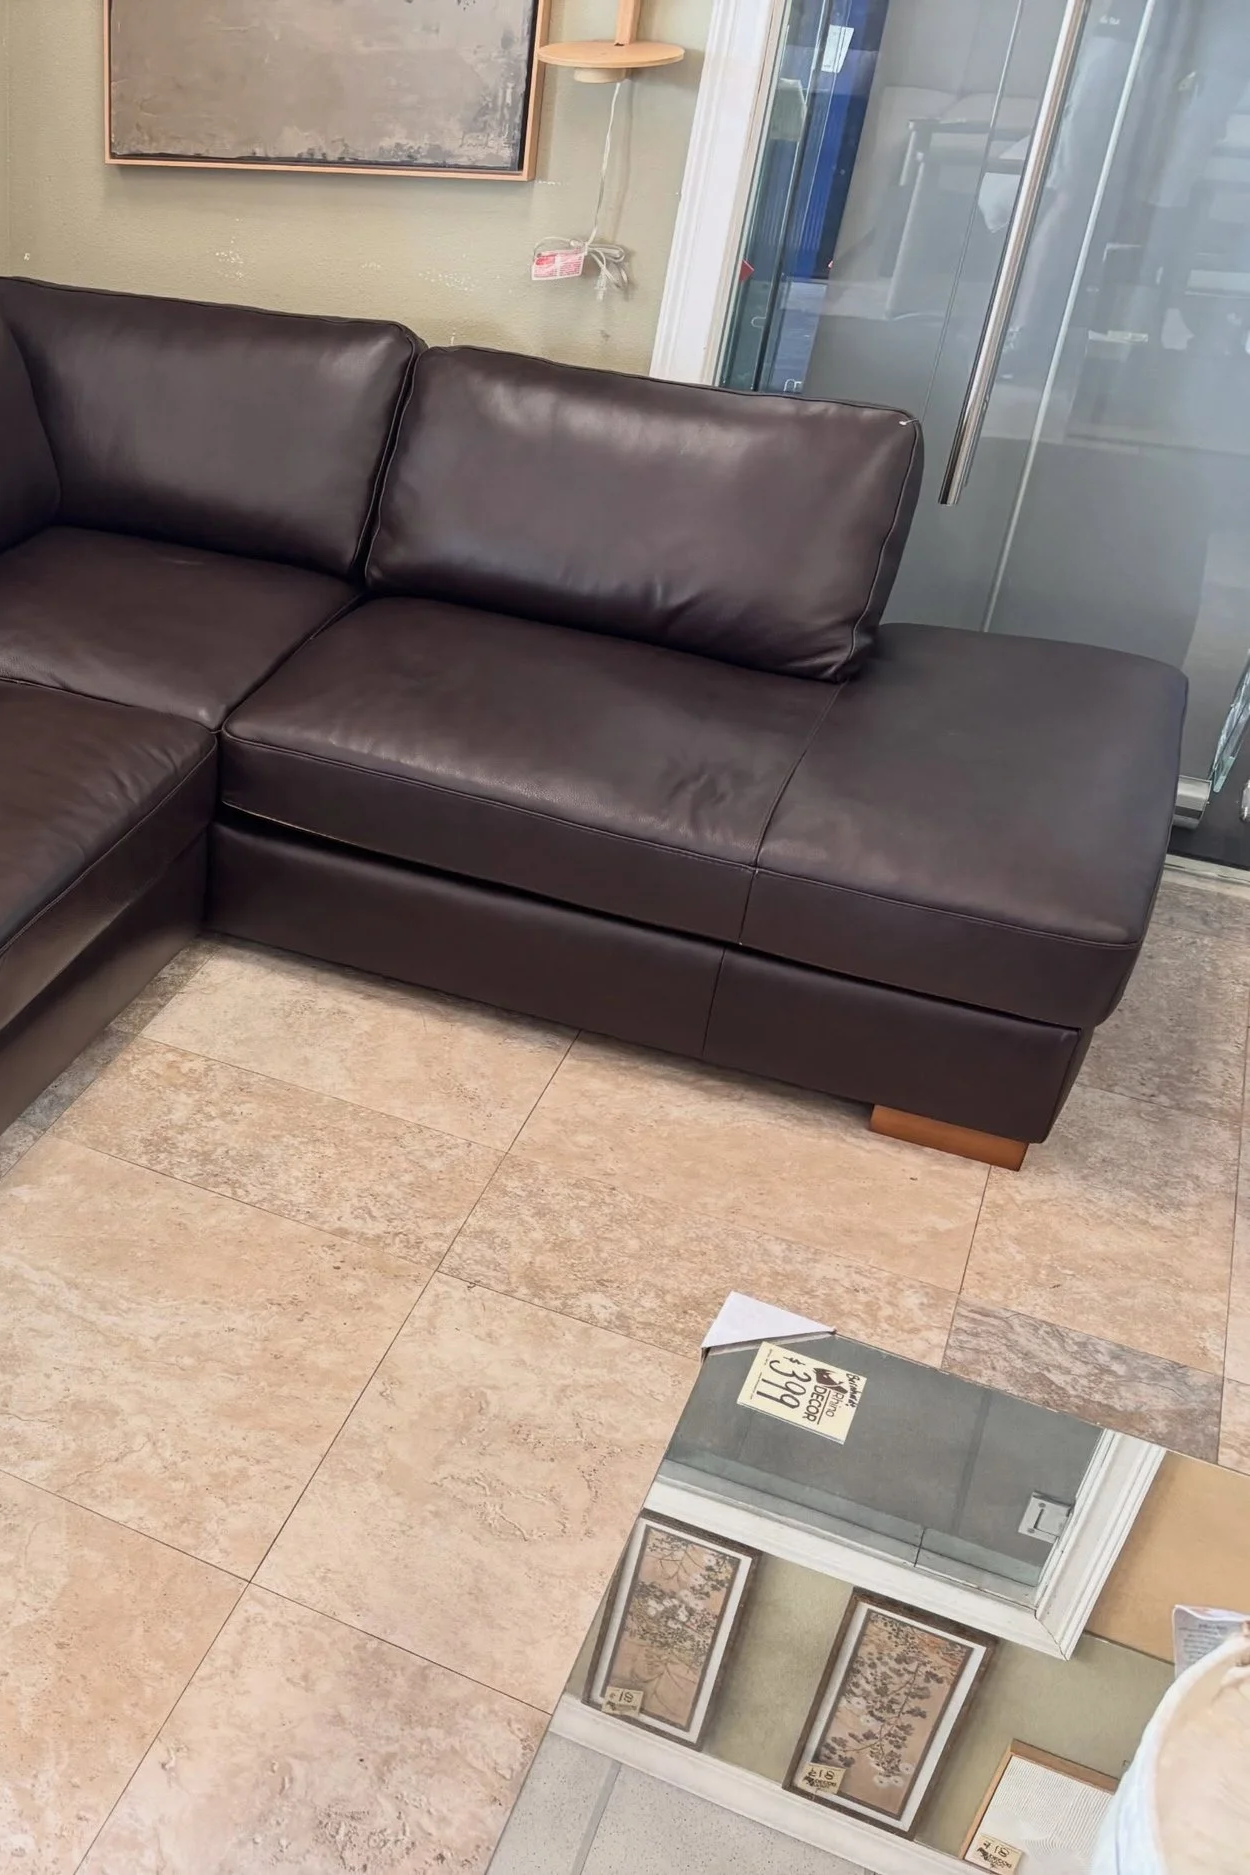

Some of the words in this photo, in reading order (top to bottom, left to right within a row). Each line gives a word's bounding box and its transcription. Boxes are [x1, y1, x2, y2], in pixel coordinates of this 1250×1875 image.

[755, 1355, 812, 1410] $399
[801, 1384, 828, 1423] DECOR
[825, 1391, 845, 1418] Rhino
